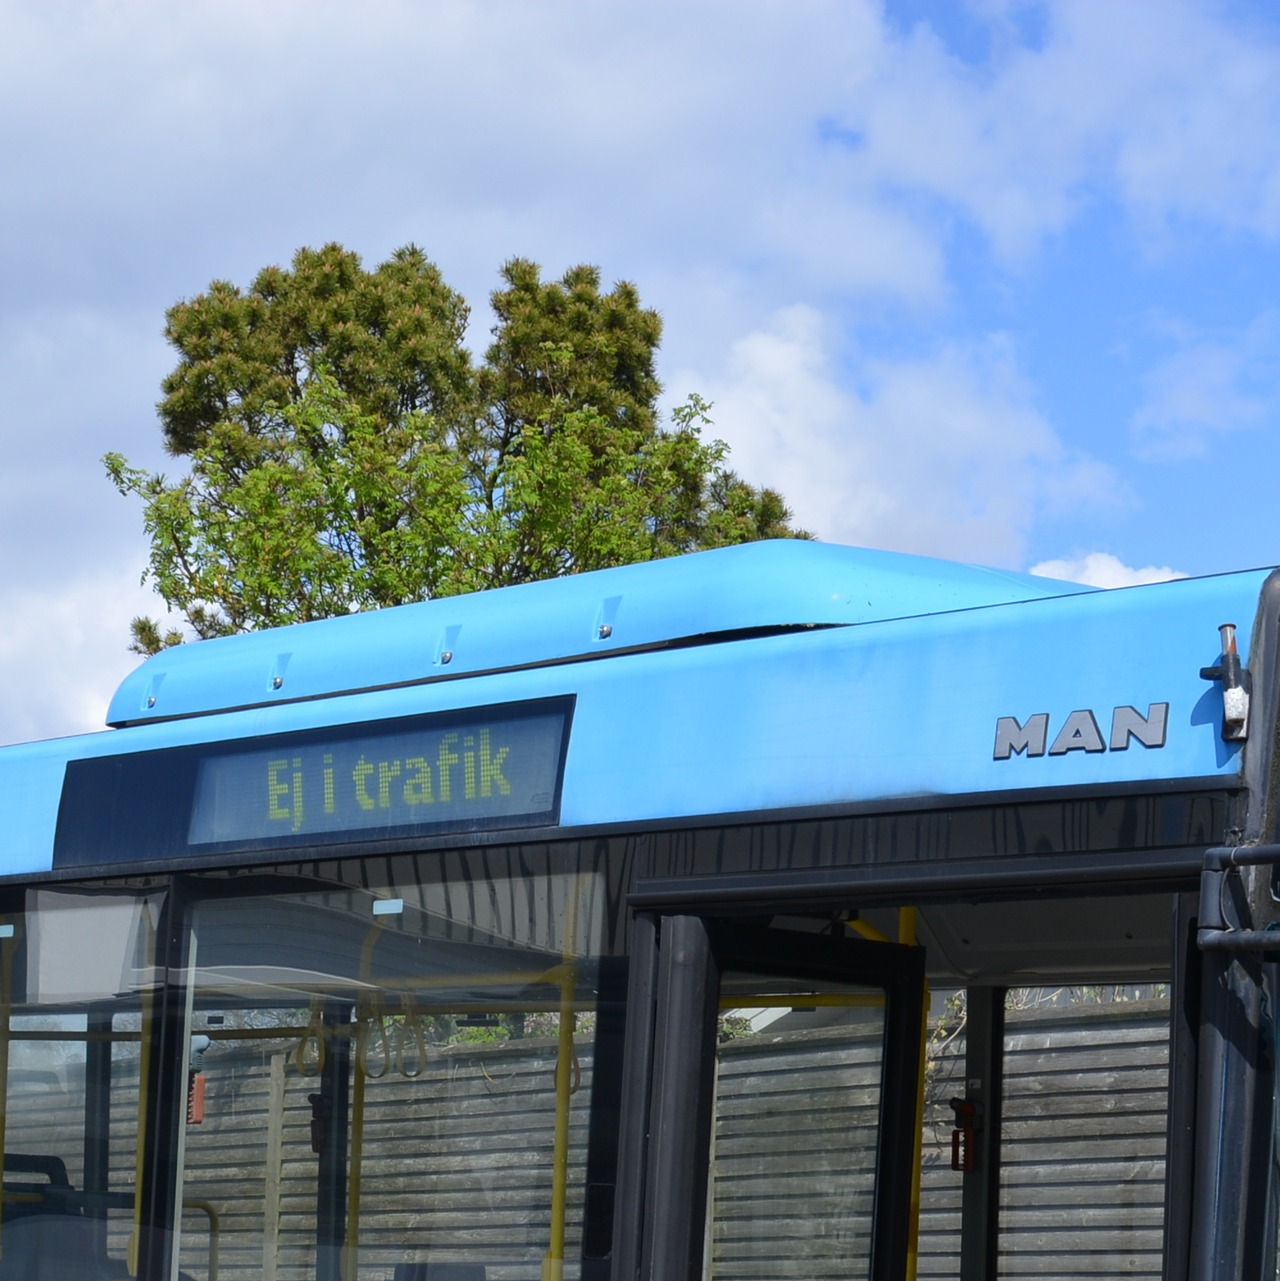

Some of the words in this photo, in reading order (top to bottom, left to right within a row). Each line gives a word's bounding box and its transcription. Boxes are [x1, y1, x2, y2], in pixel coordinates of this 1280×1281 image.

[993, 702, 1169, 761] MAN
[268, 758, 304, 832] Ej
[323, 753, 334, 814] i
[351, 728, 511, 811] trafik
